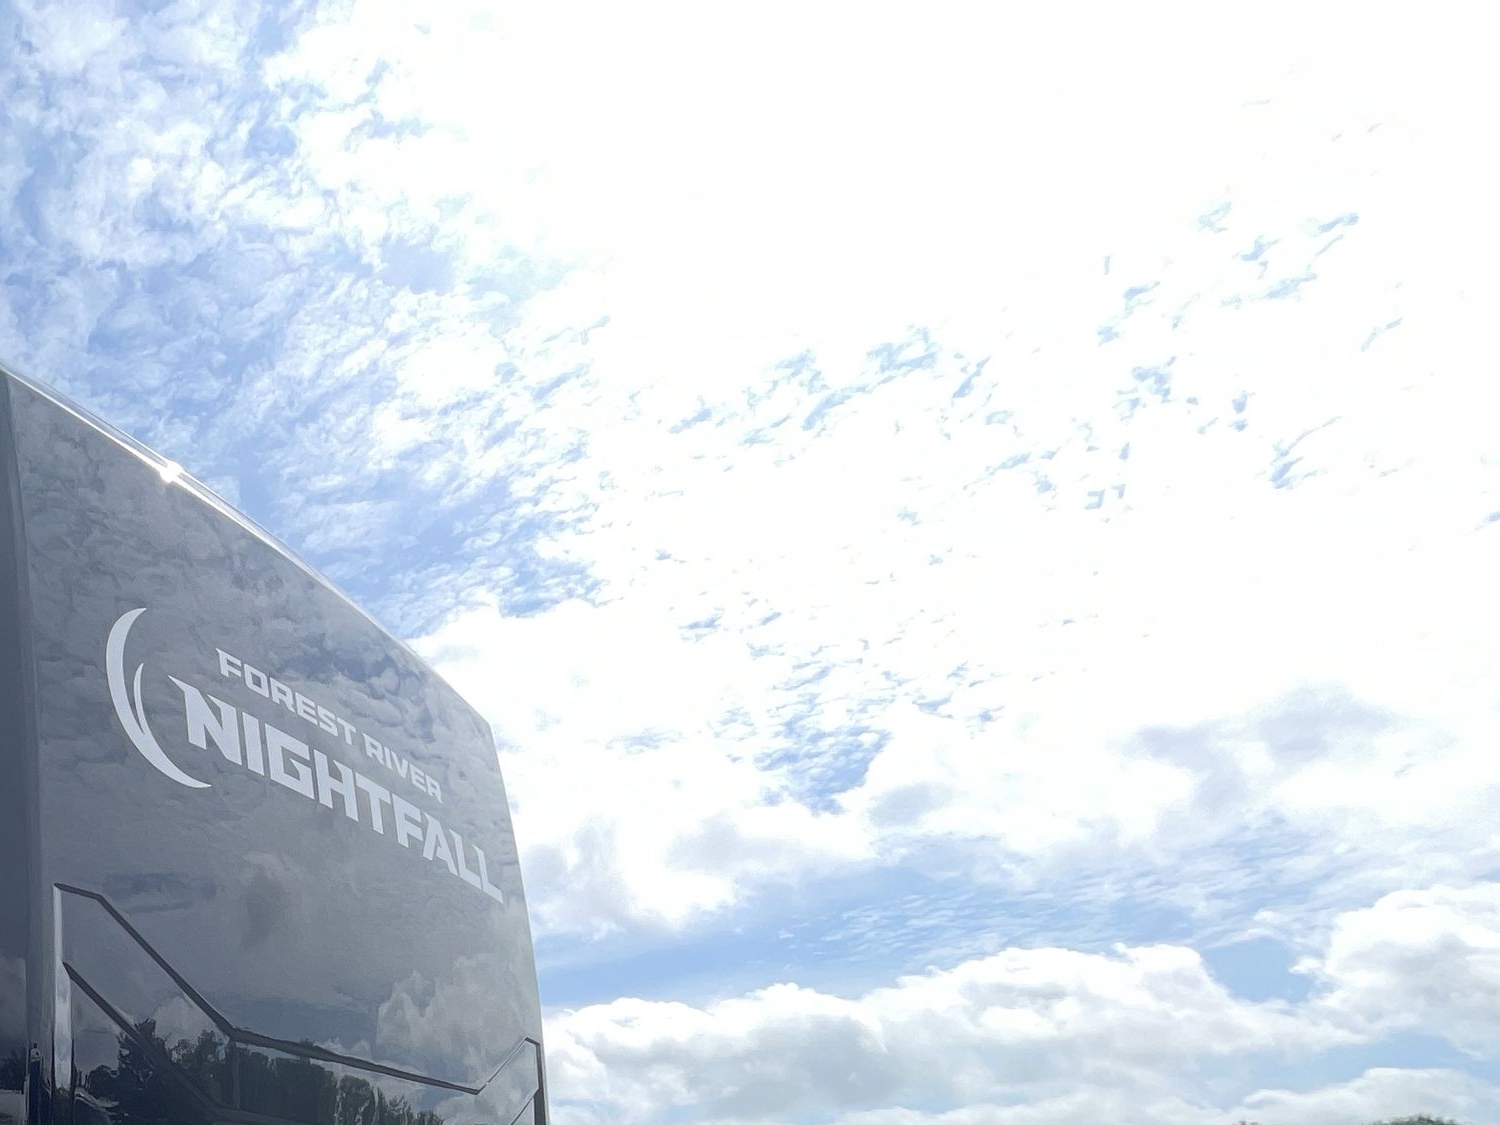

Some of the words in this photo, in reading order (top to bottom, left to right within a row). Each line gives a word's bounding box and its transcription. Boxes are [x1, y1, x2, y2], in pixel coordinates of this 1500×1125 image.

[167, 674, 504, 905] NIGHTFALL
[215, 647, 357, 745] FOREST
[362, 732, 443, 804] RIVER
